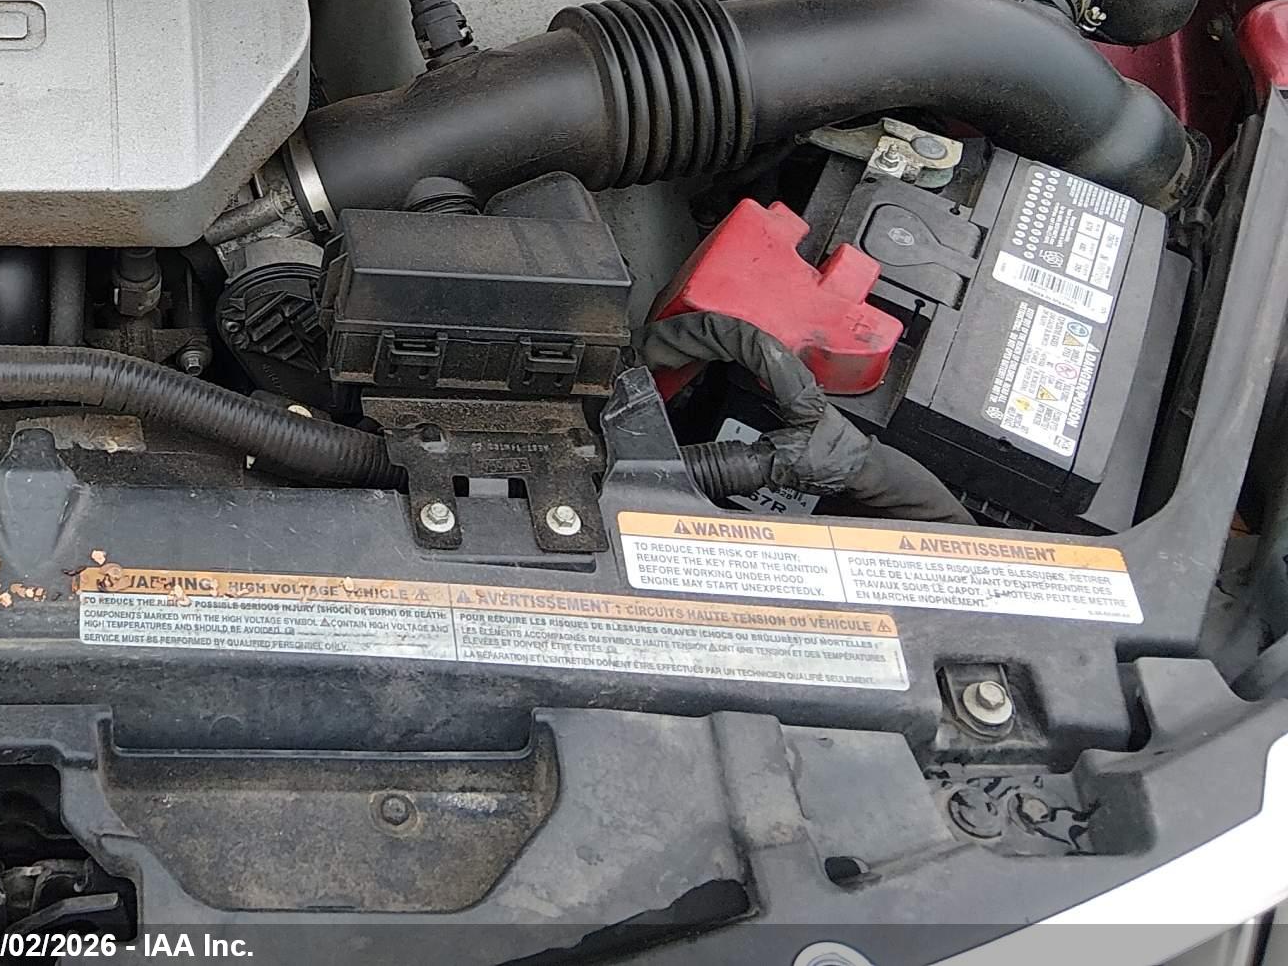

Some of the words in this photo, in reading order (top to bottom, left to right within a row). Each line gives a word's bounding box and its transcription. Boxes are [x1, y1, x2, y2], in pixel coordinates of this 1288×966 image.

[692, 521, 775, 541] WARNING
[634, 542, 648, 551] TO
[651, 543, 693, 554] REDUCE
[696, 546, 716, 556] THE
[718, 547, 743, 557] RISK
[744, 549, 758, 558] OF
[919, 537, 1056, 562] AVERTISSEMENT
[636, 553, 681, 564] REMOVE
[684, 556, 702, 566] THE
[705, 557, 726, 567] KEY
[728, 559, 758, 569] FROM
[761, 561, 780, 571] THE
[784, 562, 828, 574] IGNITION
[638, 564, 681, 575] BEFORE
[683, 567, 733, 579] WORKING
[736, 571, 771, 582] UNDER
[774, 574, 804, 584] HOOD
[848, 556, 876, 567] POUR
[924, 562, 944, 571] LES
[946, 564, 990, 575] RISQUES
[992, 567, 1006, 576] DE
[1069, 573, 1111, 585] RETIRER
[116, 575, 212, 592] ANING
[228, 580, 265, 593] HIGH
[271, 583, 339, 597] VOLTAGE
[640, 575, 679, 586] ENGINE
[682, 578, 703, 588] MAY
[706, 580, 738, 590] START
[742, 582, 824, 596] UNEXPECTEDLY.
[850, 568, 864, 577] LA
[888, 571, 902, 580] DE
[904, 572, 968, 585] L'ALLUMAGE
[970, 577, 1001, 587] AVANT
[1092, 586, 1112, 596] DES
[854, 578, 900, 590] TRAVAUX
[932, 584, 944, 593] LE
[1046, 593, 1072, 603] PEUT
[1088, 597, 1127, 607] METTRE
[856, 590, 870, 599] EN
[872, 592, 916, 602] MARCHE
[98, 597, 134, 606] REDUCE
[194, 601, 239, 610] POSSIBLE
[240, 603, 280, 612] SERIOUS
[281, 605, 314, 613] INJURY
[317, 606, 352, 615] (SHOCK
[354, 608, 366, 616] OR
[368, 609, 396, 617] BURN)
[399, 610, 412, 618] OR
[478, 591, 611, 614] AVERTISSEMENT
[625, 604, 683, 619] CIRCUITS
[687, 609, 728, 622] HAUTE
[731, 613, 785, 626] TENSION
[789, 616, 807, 627] DU
[84, 610, 142, 619] COMPONENTS
[144, 612, 179, 621] MARKED
[182, 614, 201, 622] WITH
[204, 615, 219, 623] THE
[222, 616, 242, 624] HIGH
[245, 617, 282, 625] VOLTAGE
[283, 619, 318, 627] SYMBOL
[330, 621, 366, 629] CONTAIN
[369, 622, 389, 630] HIGH
[391, 623, 429, 632] VOLTAGE
[430, 625, 448, 633] AND
[84, 620, 104, 628] HIGH
[107, 621, 172, 630] TEMPERATURES
[194, 624, 228, 633] SHOULD
[84, 634, 119, 642] SERVICE
[121, 635, 144, 643] MUST
[146, 636, 158, 644] BE
[160, 637, 211, 646] PERFORMED
[226, 639, 270, 648] QUALIFIED
